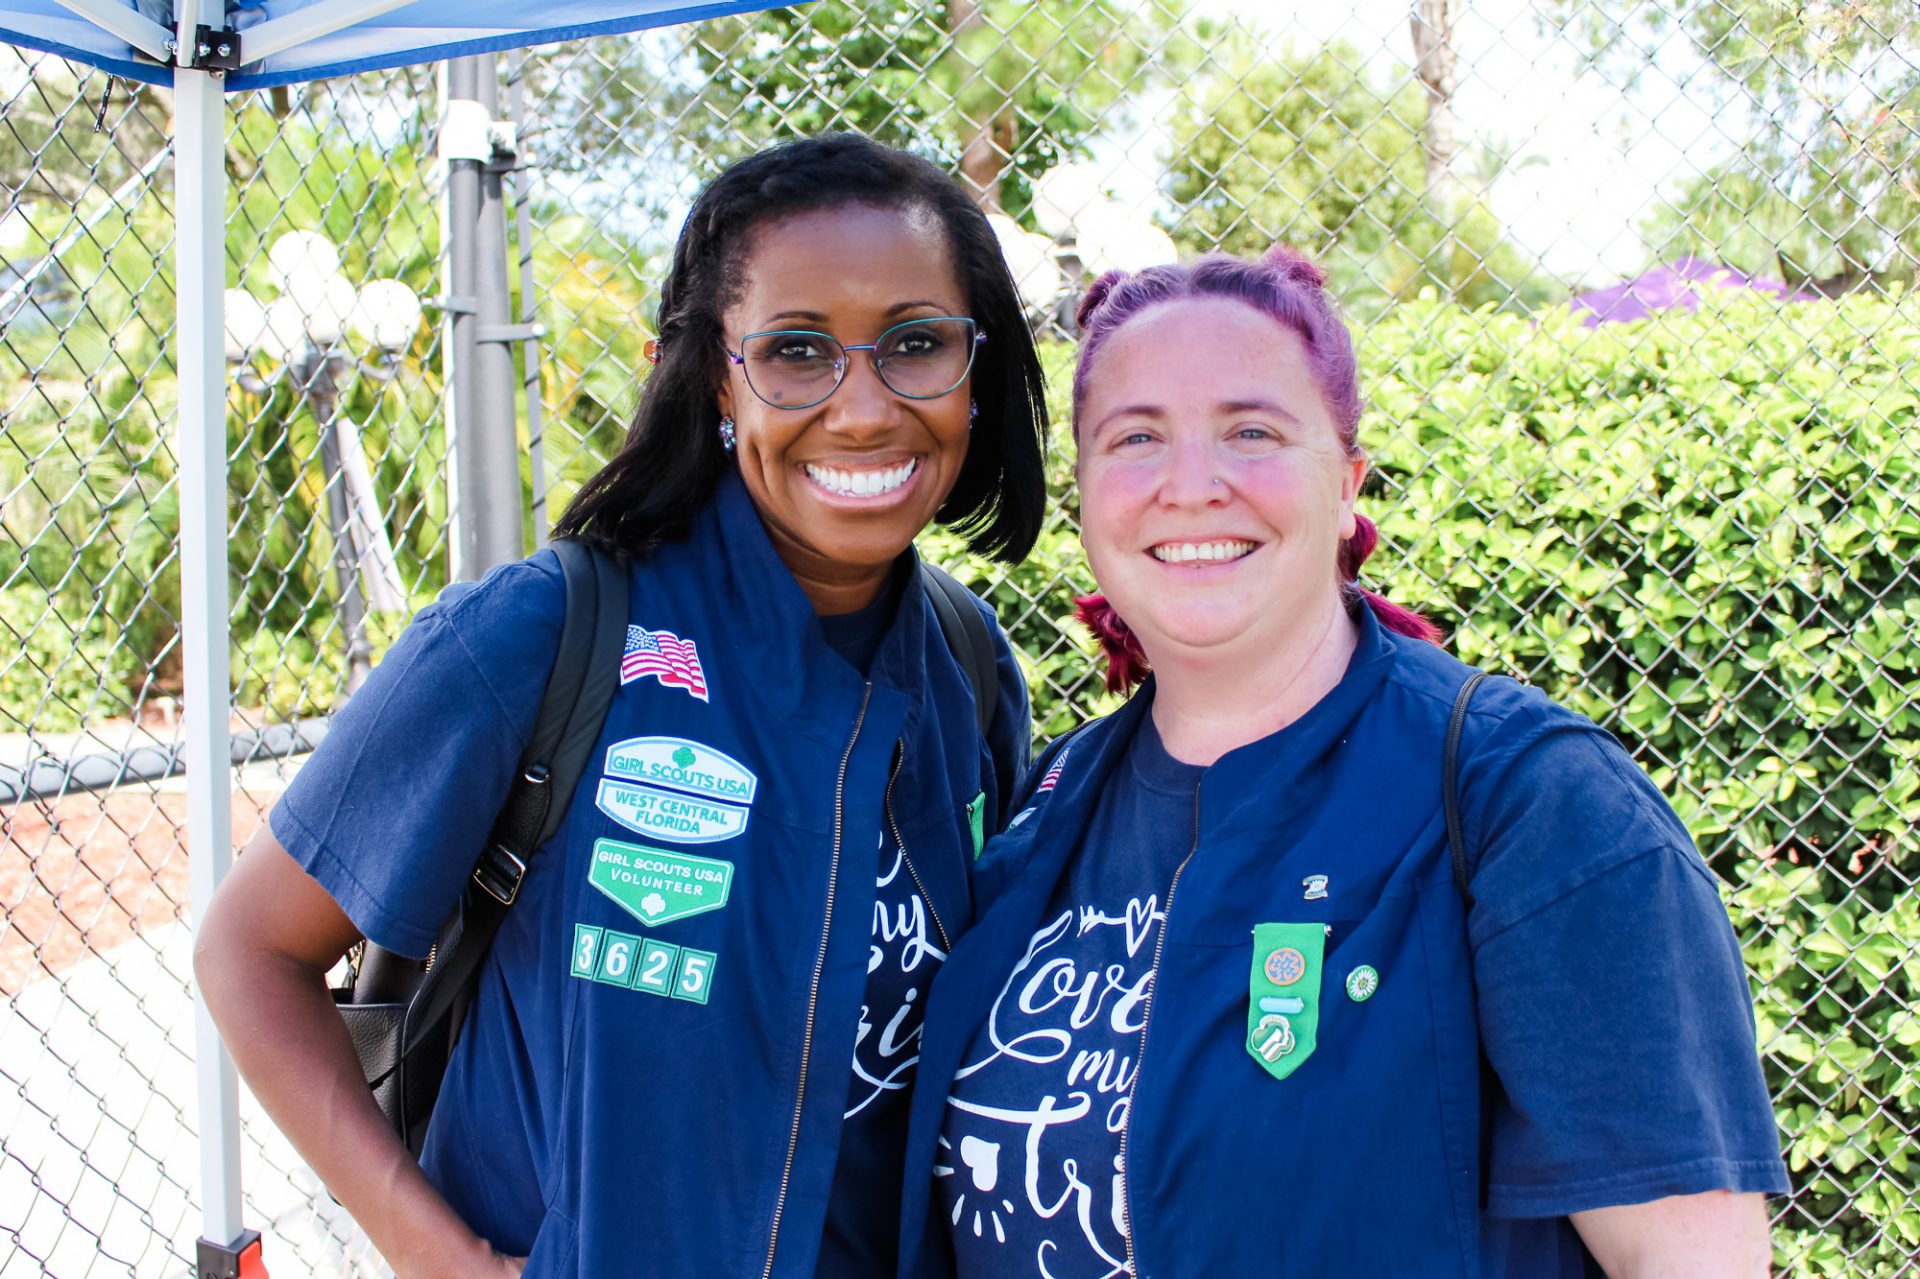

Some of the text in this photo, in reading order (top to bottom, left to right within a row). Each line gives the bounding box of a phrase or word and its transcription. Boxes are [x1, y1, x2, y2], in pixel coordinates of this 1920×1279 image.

[612, 755, 748, 795] GIRL SCOUTS USA
[615, 790, 728, 825] WEST CENTRAL
[635, 810, 700, 834] FLORIDA
[598, 851, 724, 884] GIRL SCOUTS USA
[610, 867, 704, 896] VOLUNTEER
[577, 933, 708, 993] 3625
